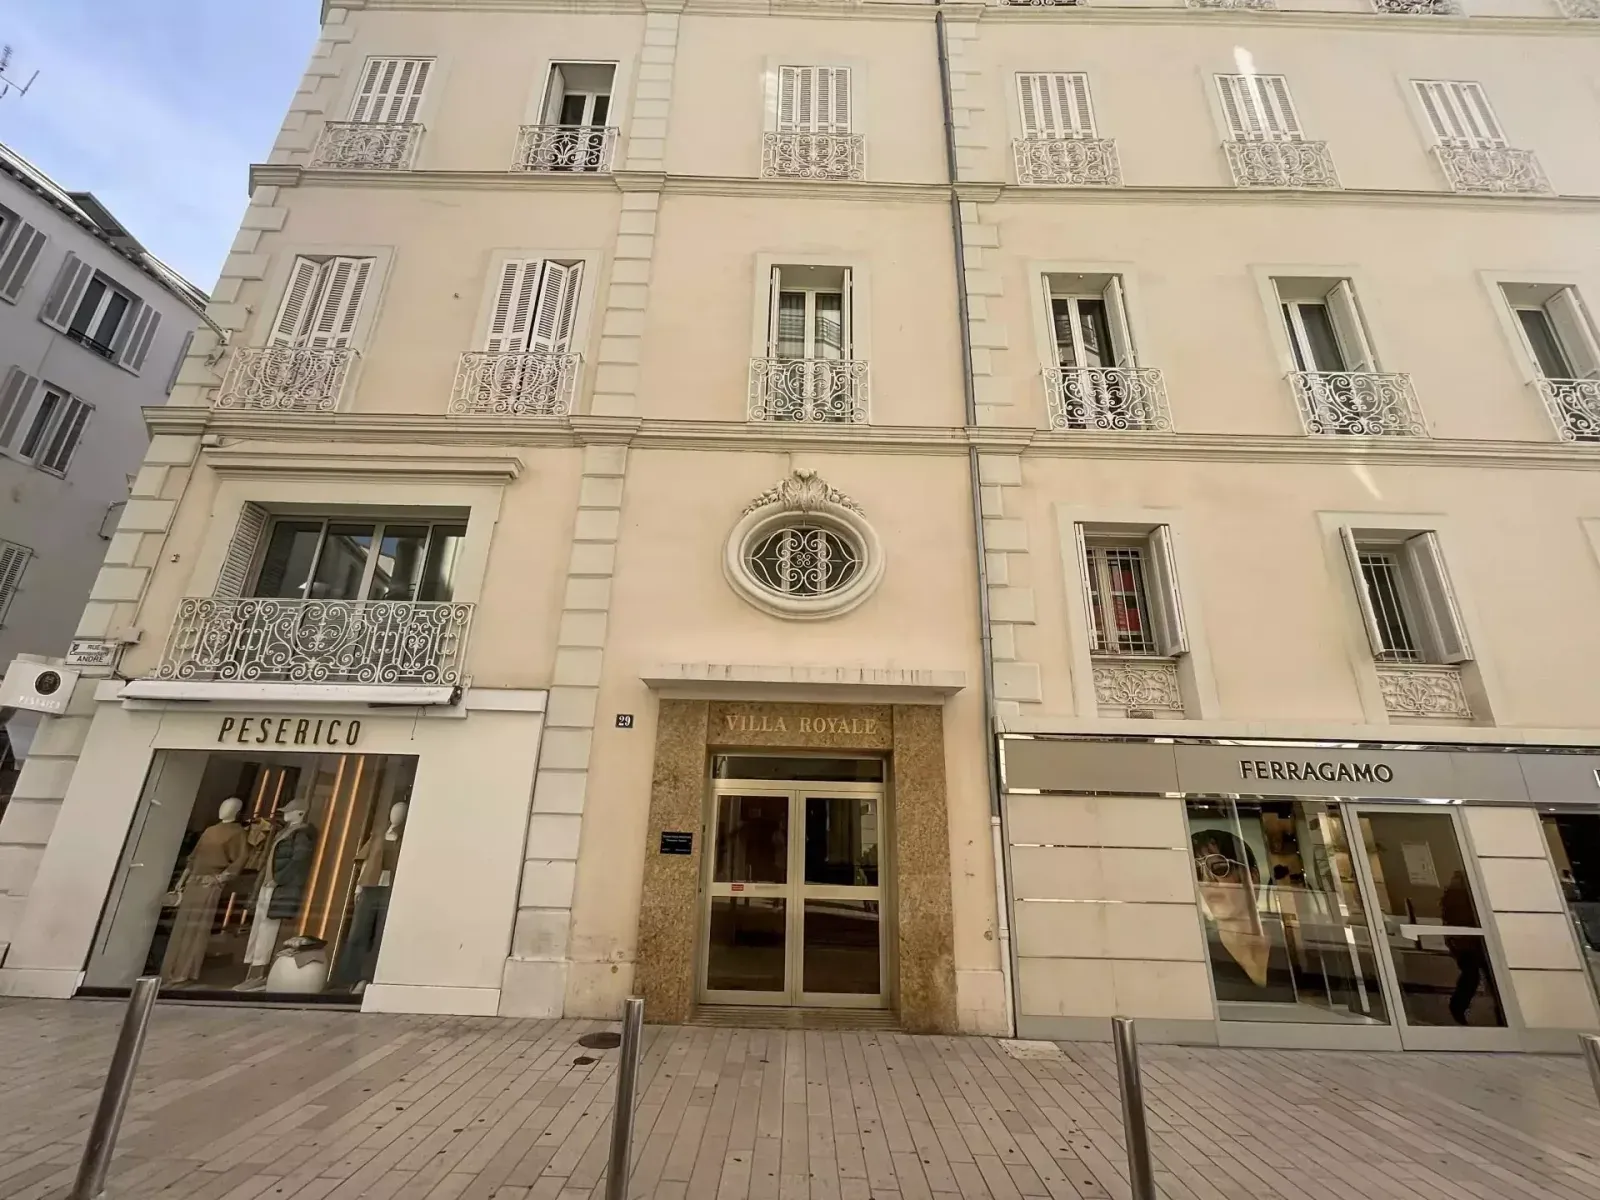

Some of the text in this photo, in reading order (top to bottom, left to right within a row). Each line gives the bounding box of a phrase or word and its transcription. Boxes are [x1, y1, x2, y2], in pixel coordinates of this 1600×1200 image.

[217, 717, 361, 746] PESERICO
[618, 715, 631, 727] 29
[726, 715, 877, 734] VILLA ROYALE
[1239, 760, 1394, 783] FERRAGAMO
